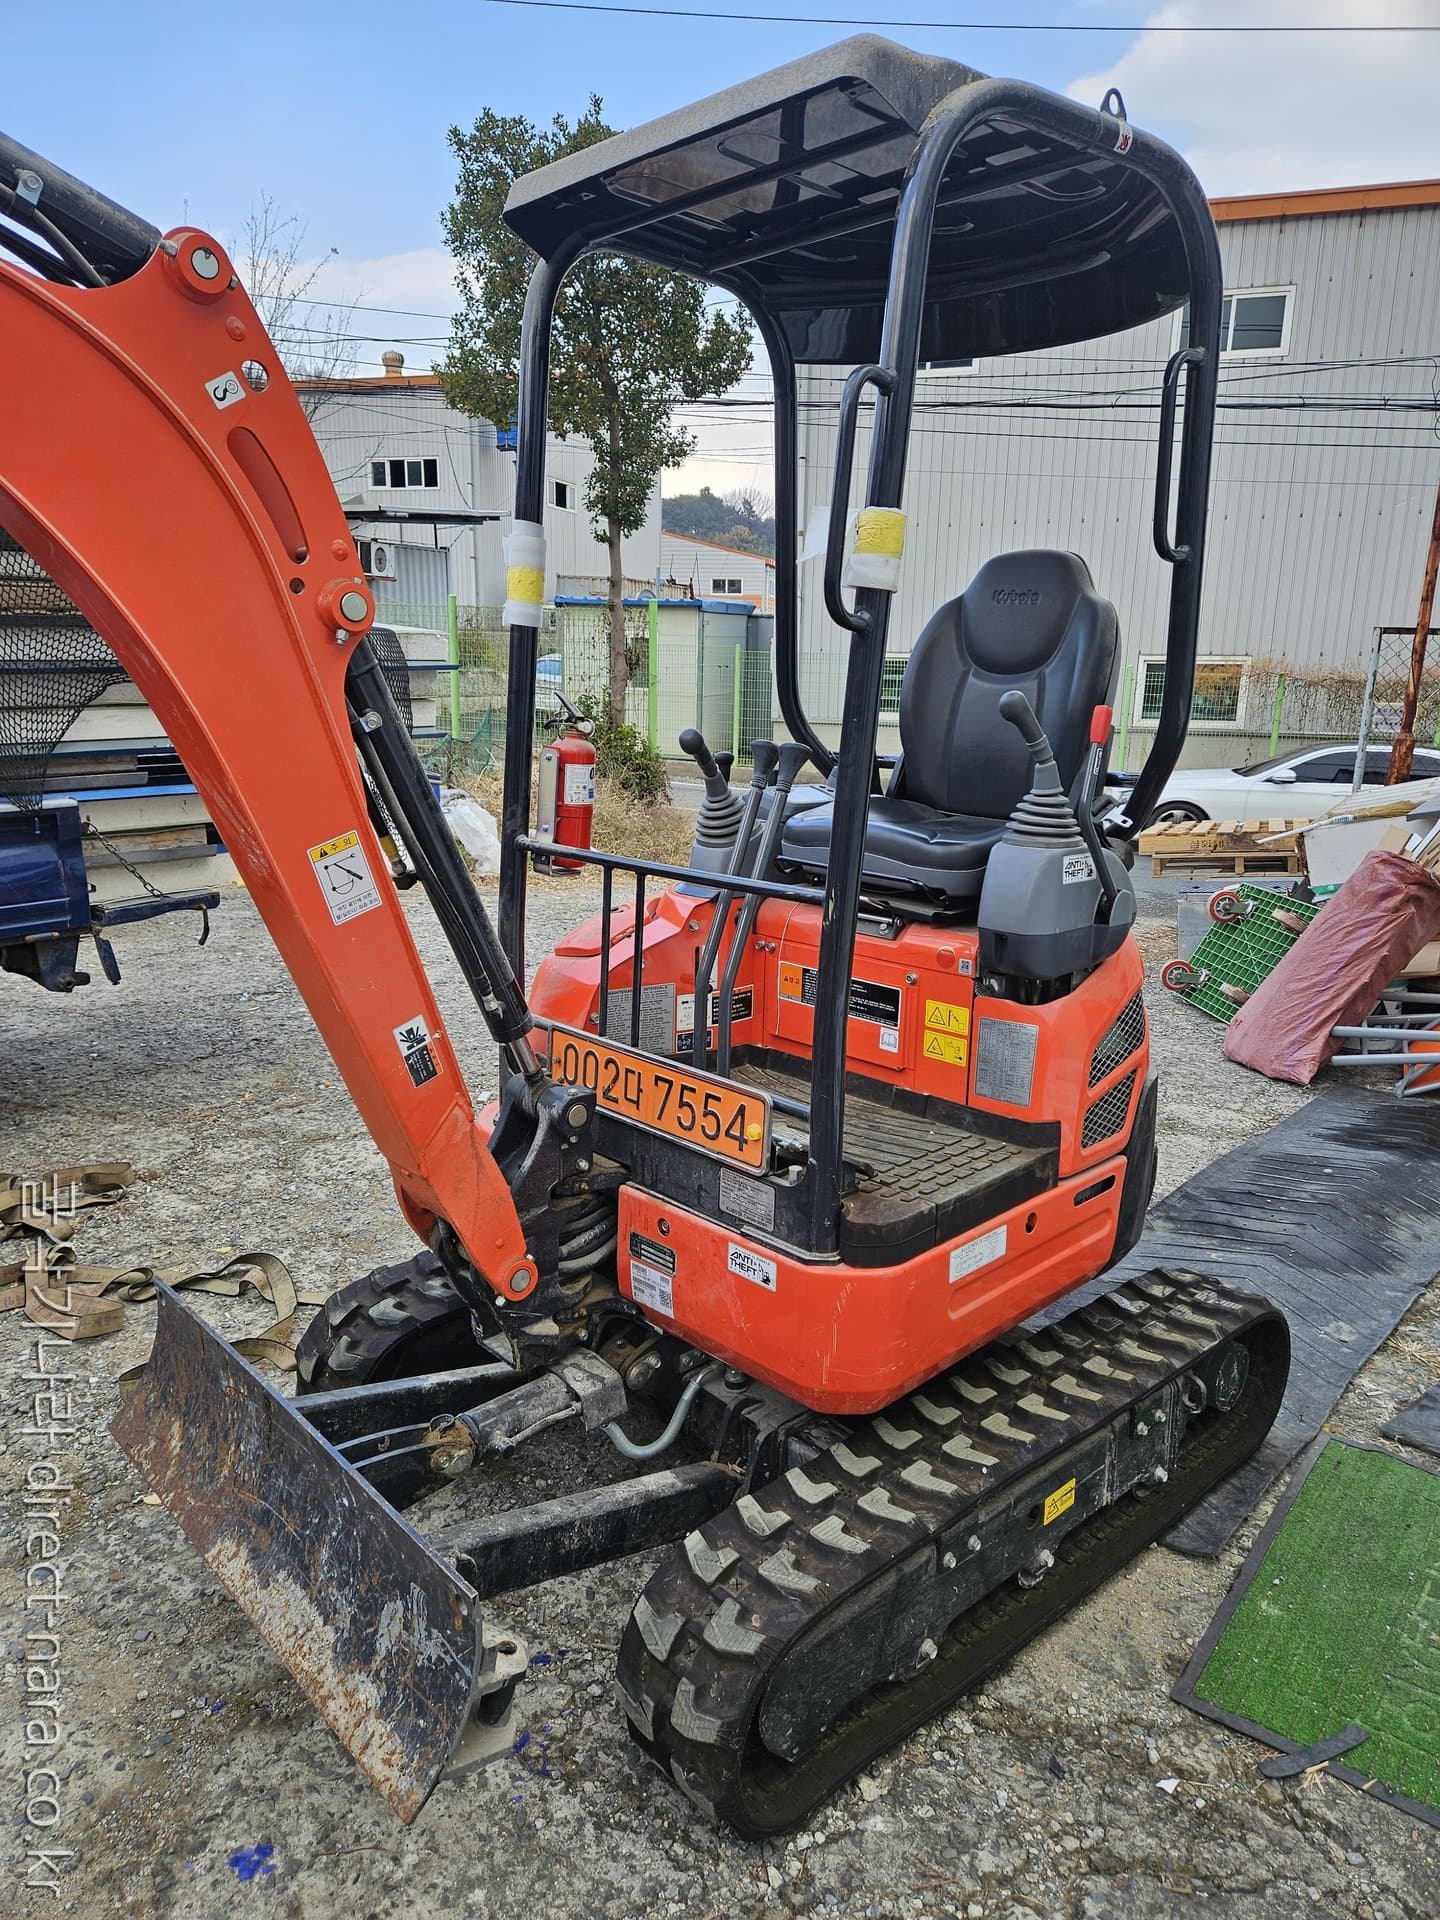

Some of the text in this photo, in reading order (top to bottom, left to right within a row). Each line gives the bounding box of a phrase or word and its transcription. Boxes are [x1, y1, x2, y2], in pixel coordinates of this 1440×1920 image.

[1064, 860, 1082, 870] ANTI
[1064, 867, 1084, 879] THEFT
[653, 1073, 749, 1152] 7554
[729, 1257, 757, 1276] THEFT
[730, 1251, 754, 1267] ANTI
